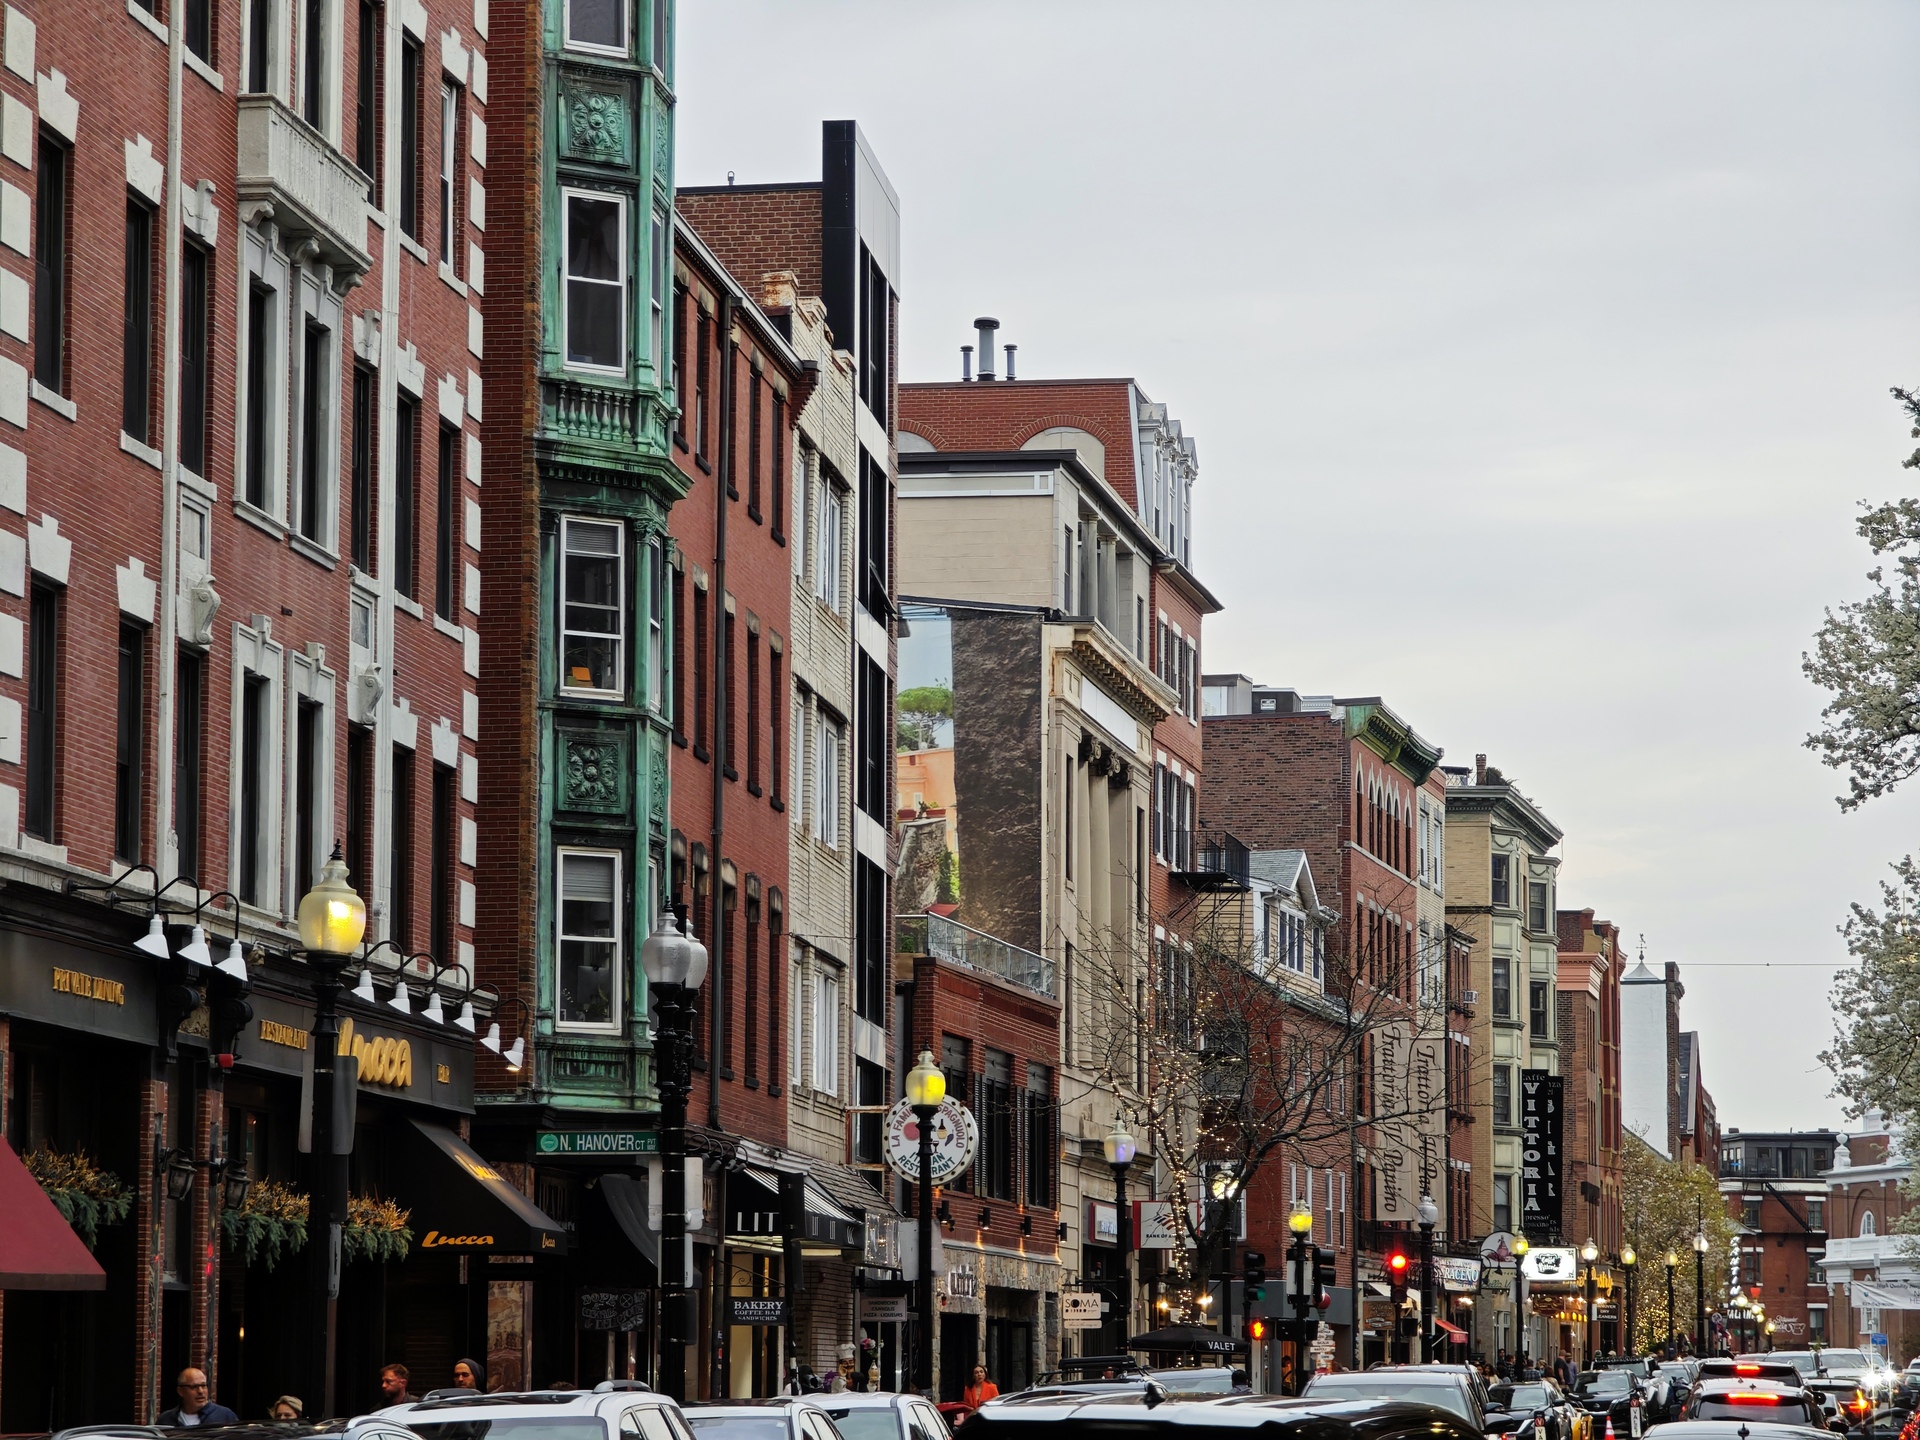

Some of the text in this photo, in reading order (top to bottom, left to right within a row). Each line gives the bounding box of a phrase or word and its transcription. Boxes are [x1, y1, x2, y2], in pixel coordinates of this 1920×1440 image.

[91, 976, 125, 1006] DINING
[260, 1019, 308, 1051] RESTAURANT
[560, 1134, 646, 1151] N. HANOVER CT
[891, 1134, 901, 1148] LA
[1522, 1082, 1542, 1211] VITTORIA
[1383, 1148, 1404, 1213] Panino
[421, 1231, 494, 1248] Lucca
[542, 1232, 556, 1248] Lucca
[734, 1301, 784, 1310] BAKERY
[1065, 1298, 1099, 1309] SOMA
[1207, 1341, 1236, 1351] VALET
